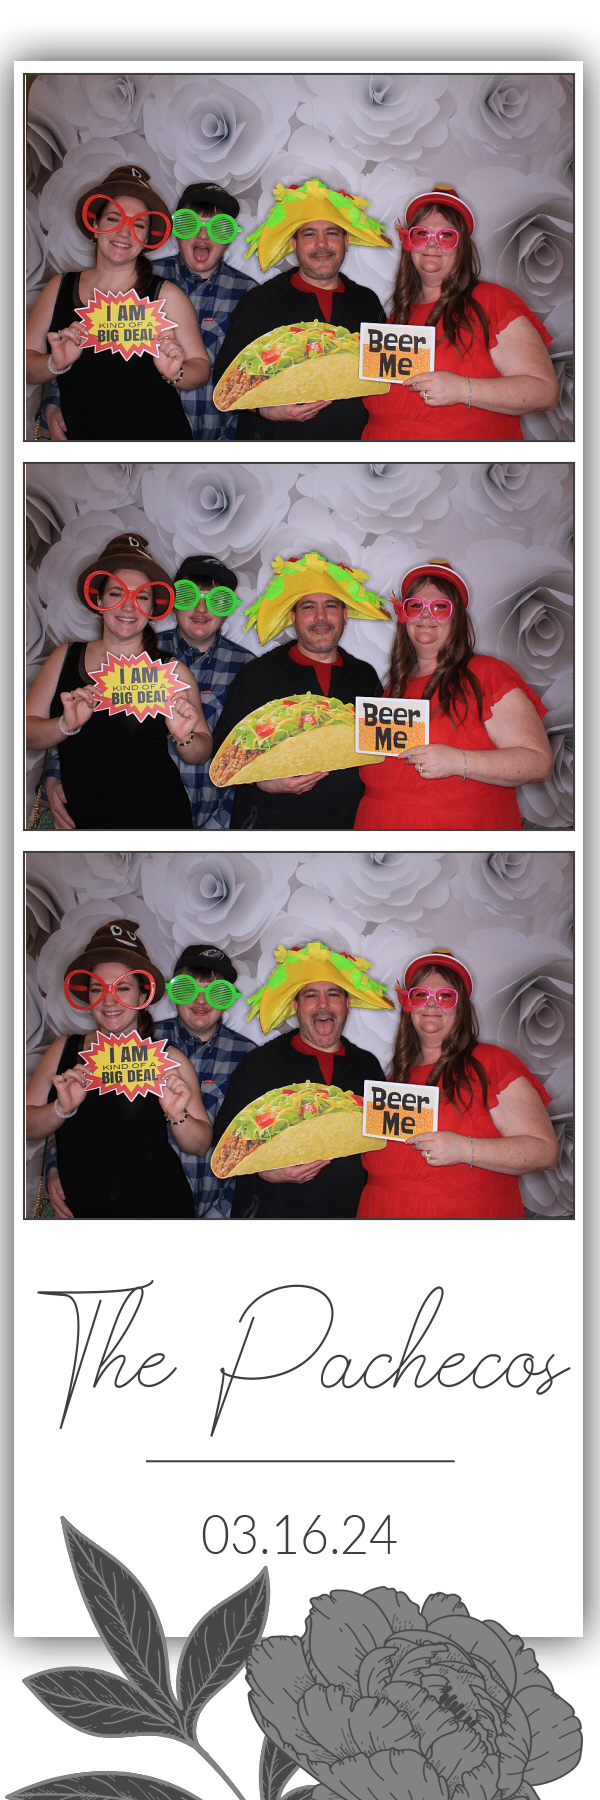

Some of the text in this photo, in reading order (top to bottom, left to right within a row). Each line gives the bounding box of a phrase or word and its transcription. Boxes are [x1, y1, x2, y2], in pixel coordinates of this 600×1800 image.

[106, 304, 146, 322] I AM
[97, 328, 156, 343] BIG DEAL
[367, 328, 427, 355] Beer
[379, 352, 413, 378] Me
[120, 666, 158, 685] I AM
[112, 684, 139, 692] KIND
[111, 690, 169, 706] BIG DEAL
[362, 702, 421, 728] Beer
[374, 726, 408, 752] Me
[110, 1045, 148, 1064] I AM
[102, 1062, 129, 1071] KIND
[101, 1068, 159, 1085] BIG DEAL
[371, 1086, 430, 1114] Beer
[382, 1110, 416, 1137] Me
